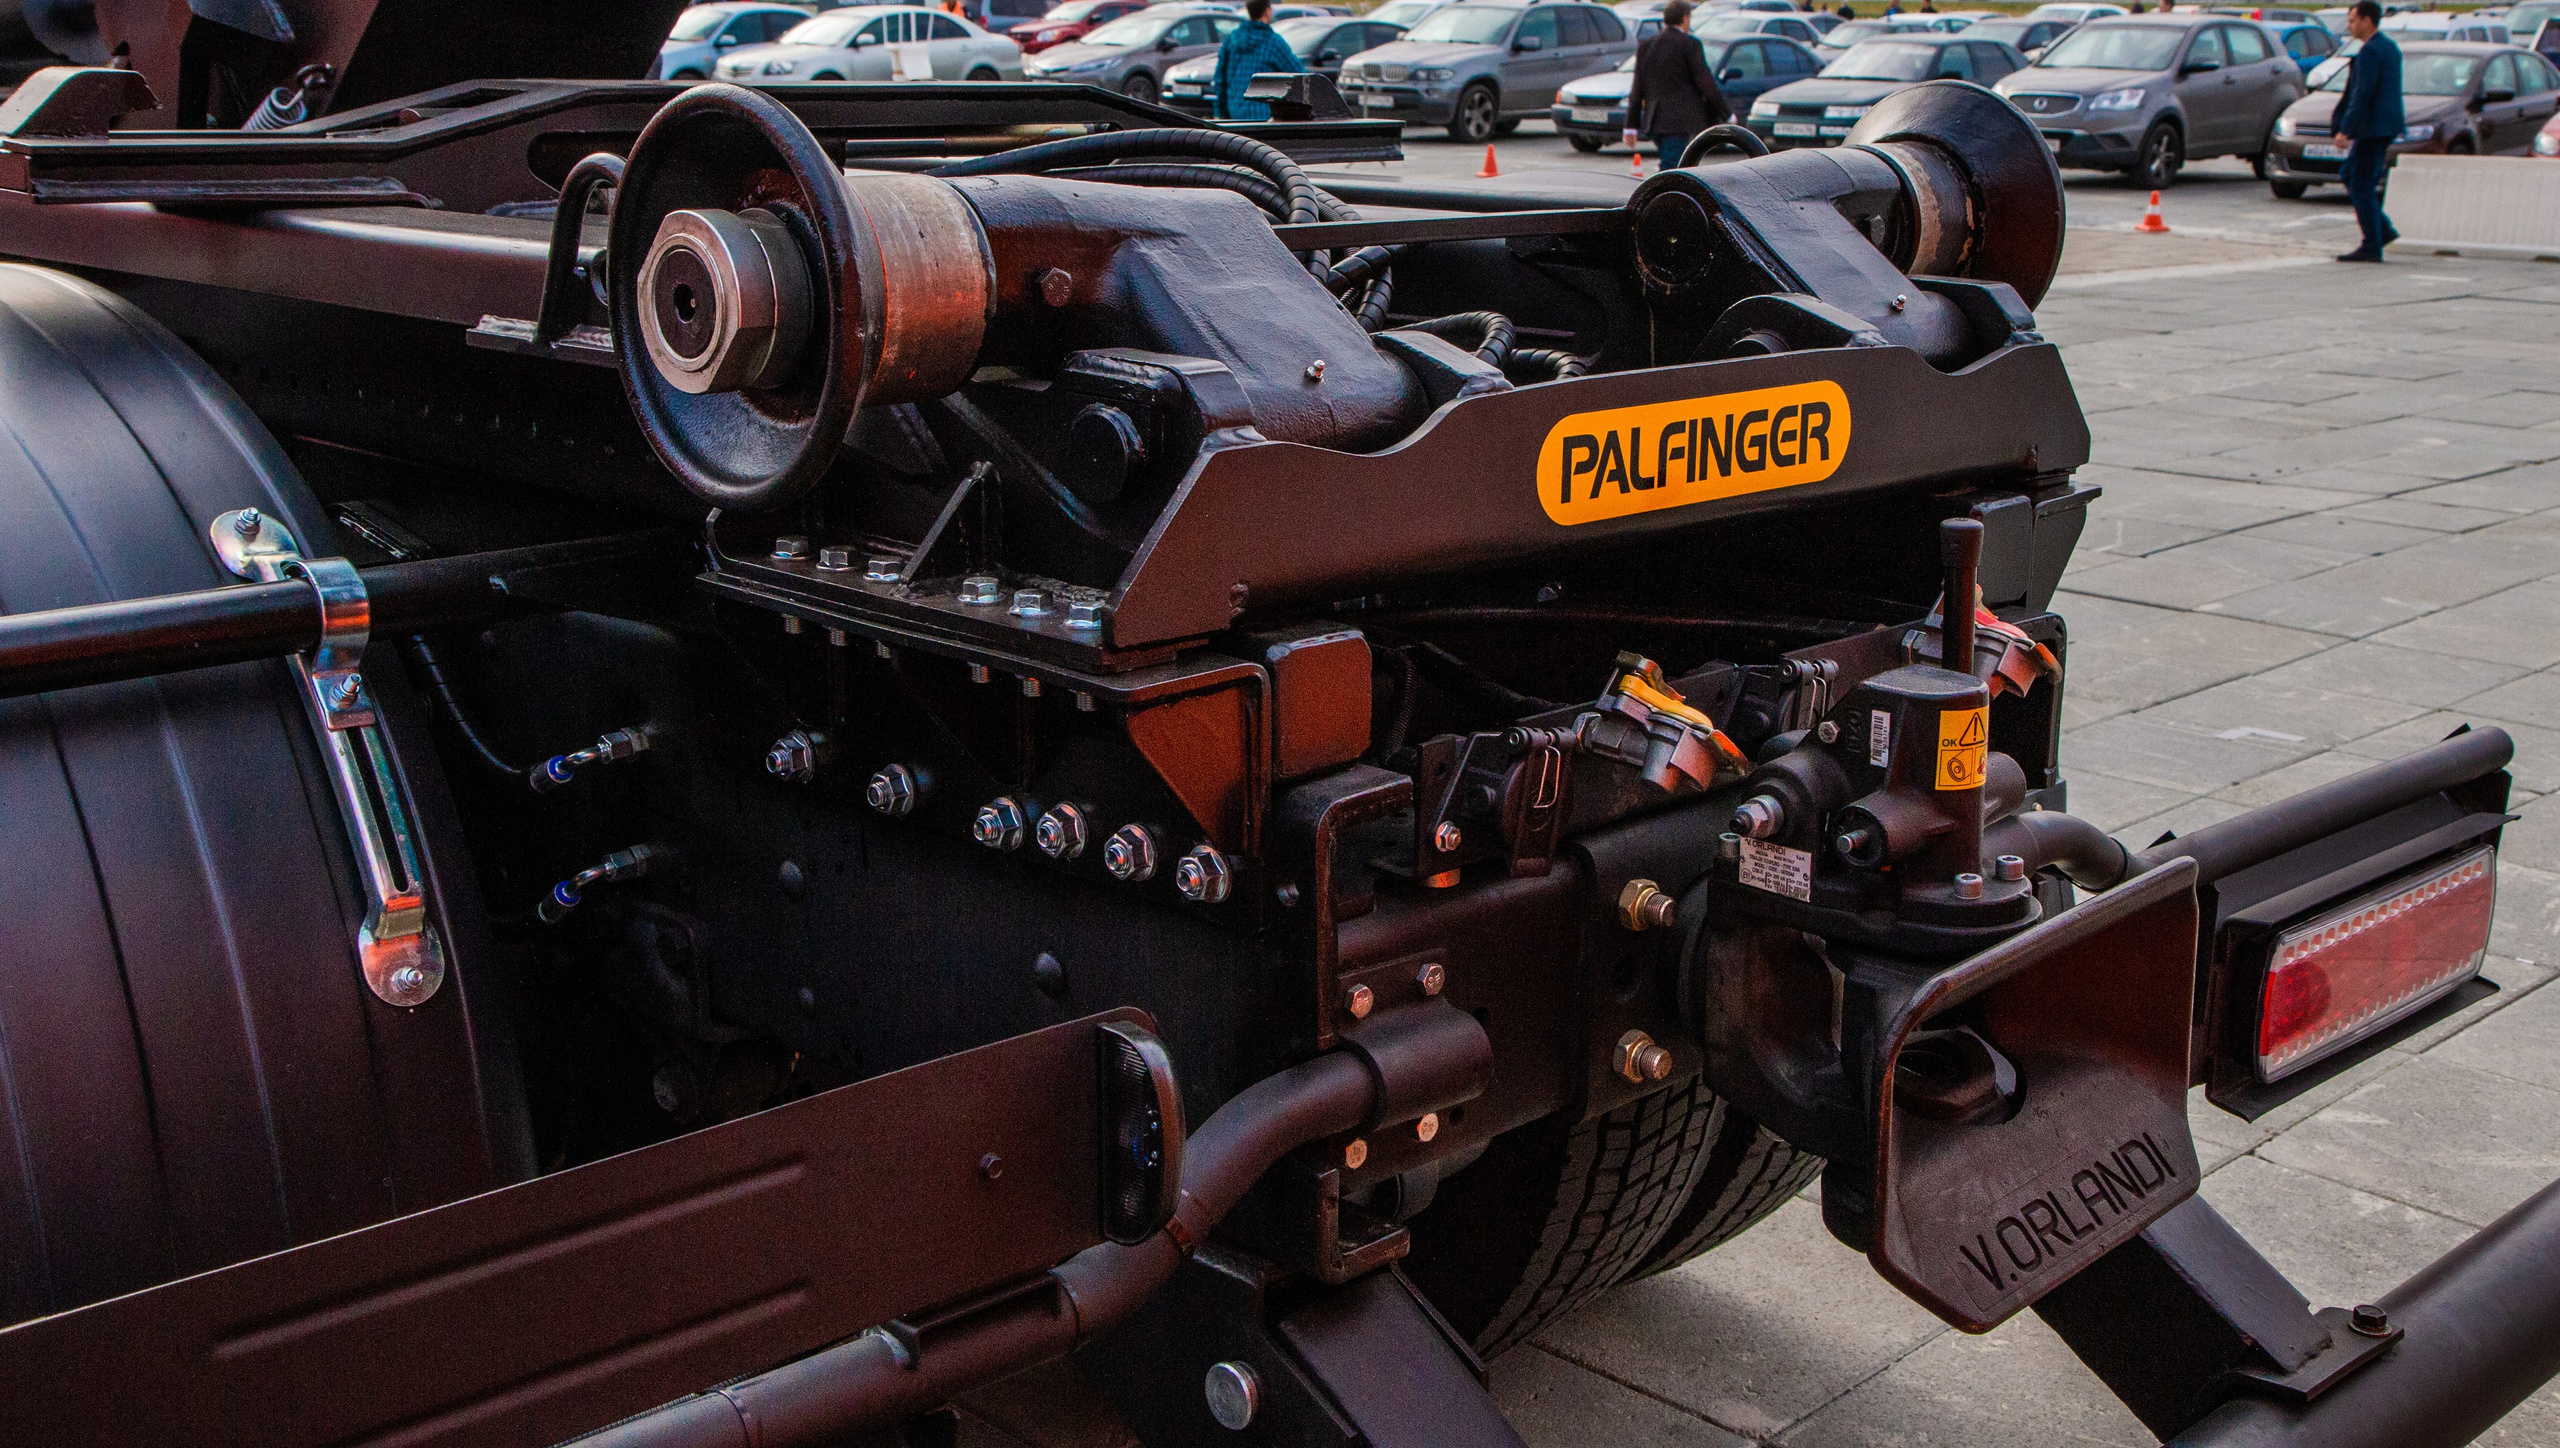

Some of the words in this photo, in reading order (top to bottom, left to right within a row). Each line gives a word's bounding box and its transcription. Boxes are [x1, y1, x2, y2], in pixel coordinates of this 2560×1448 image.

[1561, 401, 1831, 504] PALFINGER
[1942, 738, 1957, 747] OK
[1959, 1132, 2176, 1291] V.ORLANDI
